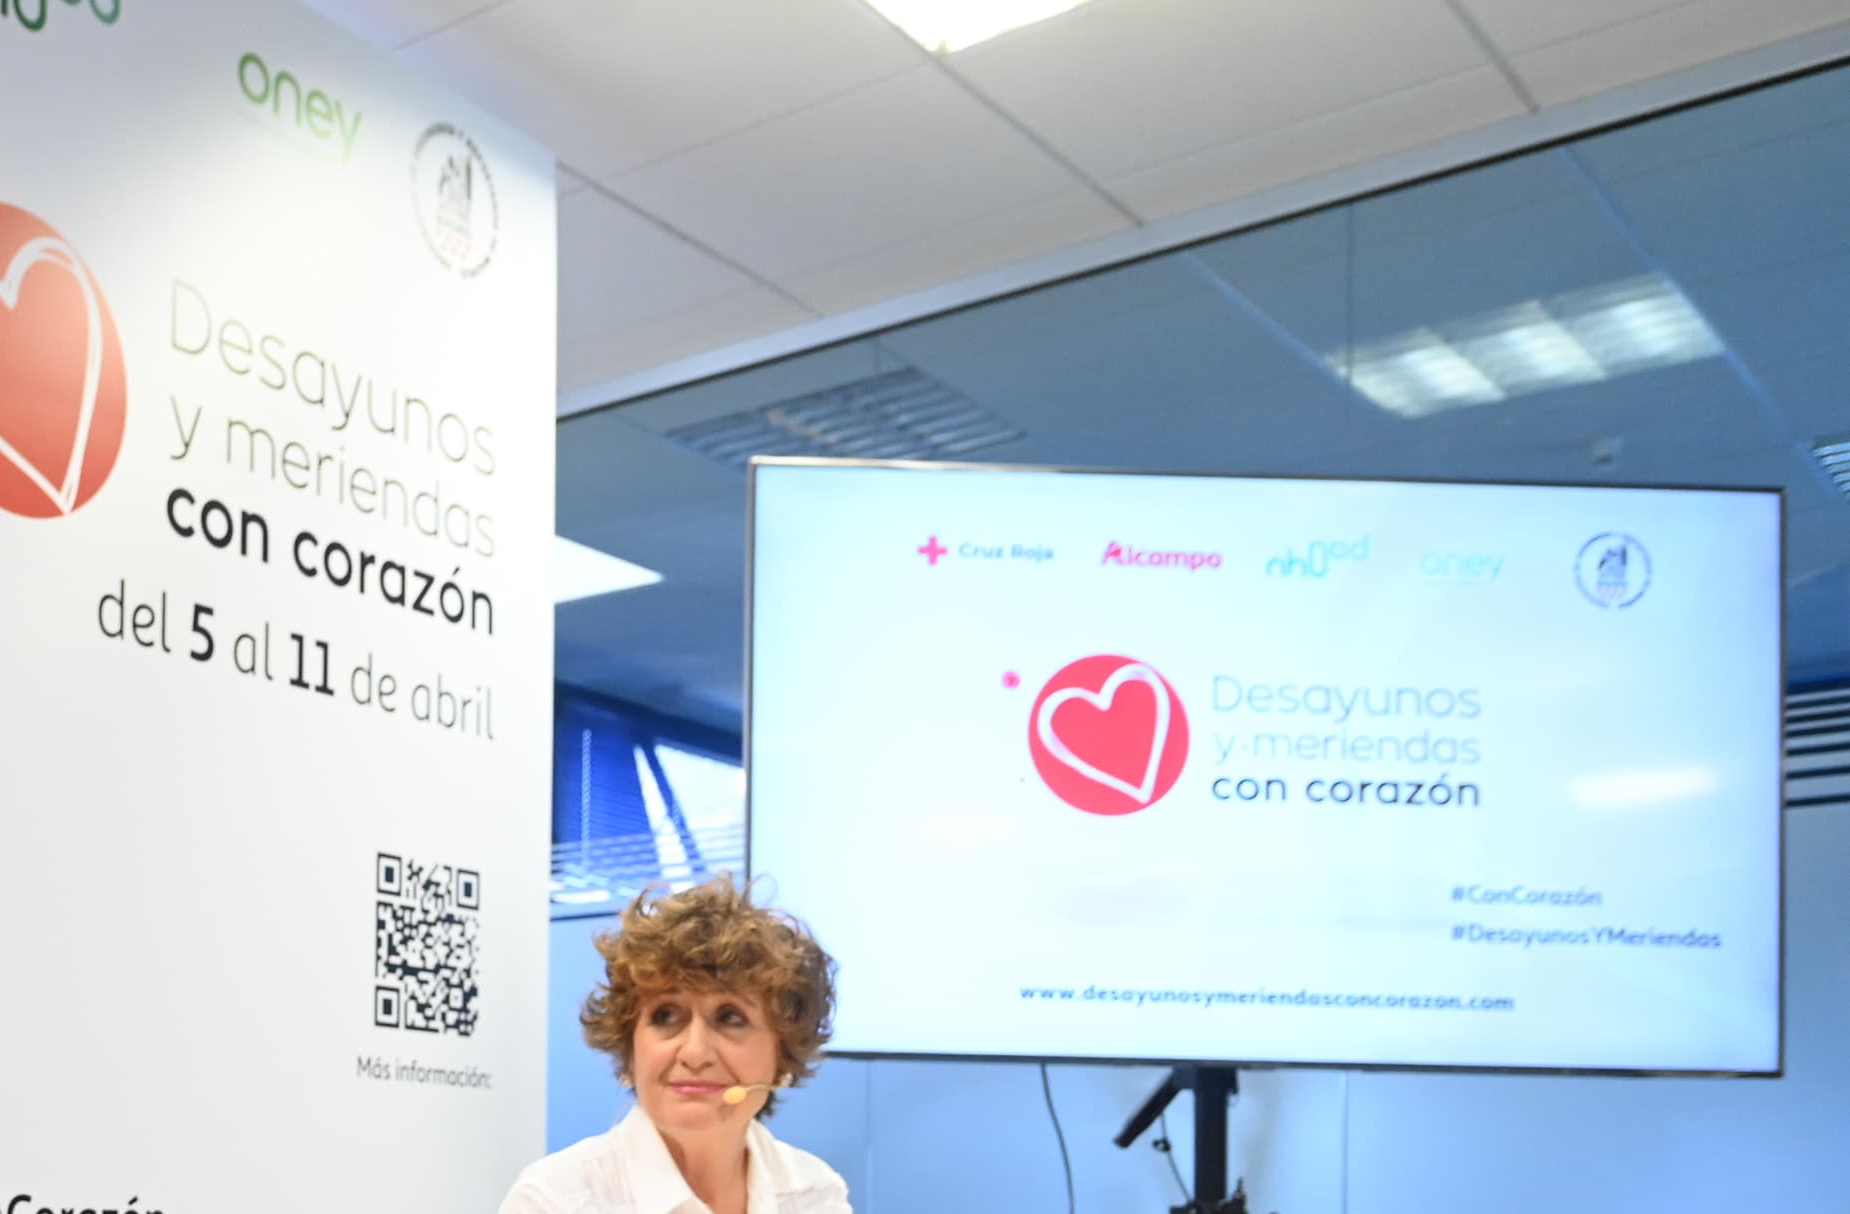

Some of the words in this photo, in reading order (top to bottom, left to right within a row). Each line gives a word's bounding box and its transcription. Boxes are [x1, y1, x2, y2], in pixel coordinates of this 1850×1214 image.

[238, 52, 362, 163] oney
[171, 279, 494, 476] Desayunos
[170, 395, 202, 461] y
[226, 416, 495, 558] meriendas
[167, 487, 269, 563] con
[293, 531, 494, 636] corazón
[1101, 540, 1223, 571] Alcampo
[98, 578, 172, 654] del
[189, 603, 215, 662] 5
[233, 622, 273, 682] al
[289, 632, 335, 697] 11
[350, 652, 397, 713] de
[411, 672, 494, 741] abril
[1211, 674, 1483, 725] Desayunos
[1213, 732, 1237, 766] y
[1252, 728, 1483, 765] meriendas
[1211, 777, 1288, 802] con
[1305, 771, 1481, 807] corazón
[1452, 884, 1604, 907] #ConCorazón
[1452, 924, 1723, 949] #DesayunosYMeriendas
[356, 1055, 391, 1081] Más
